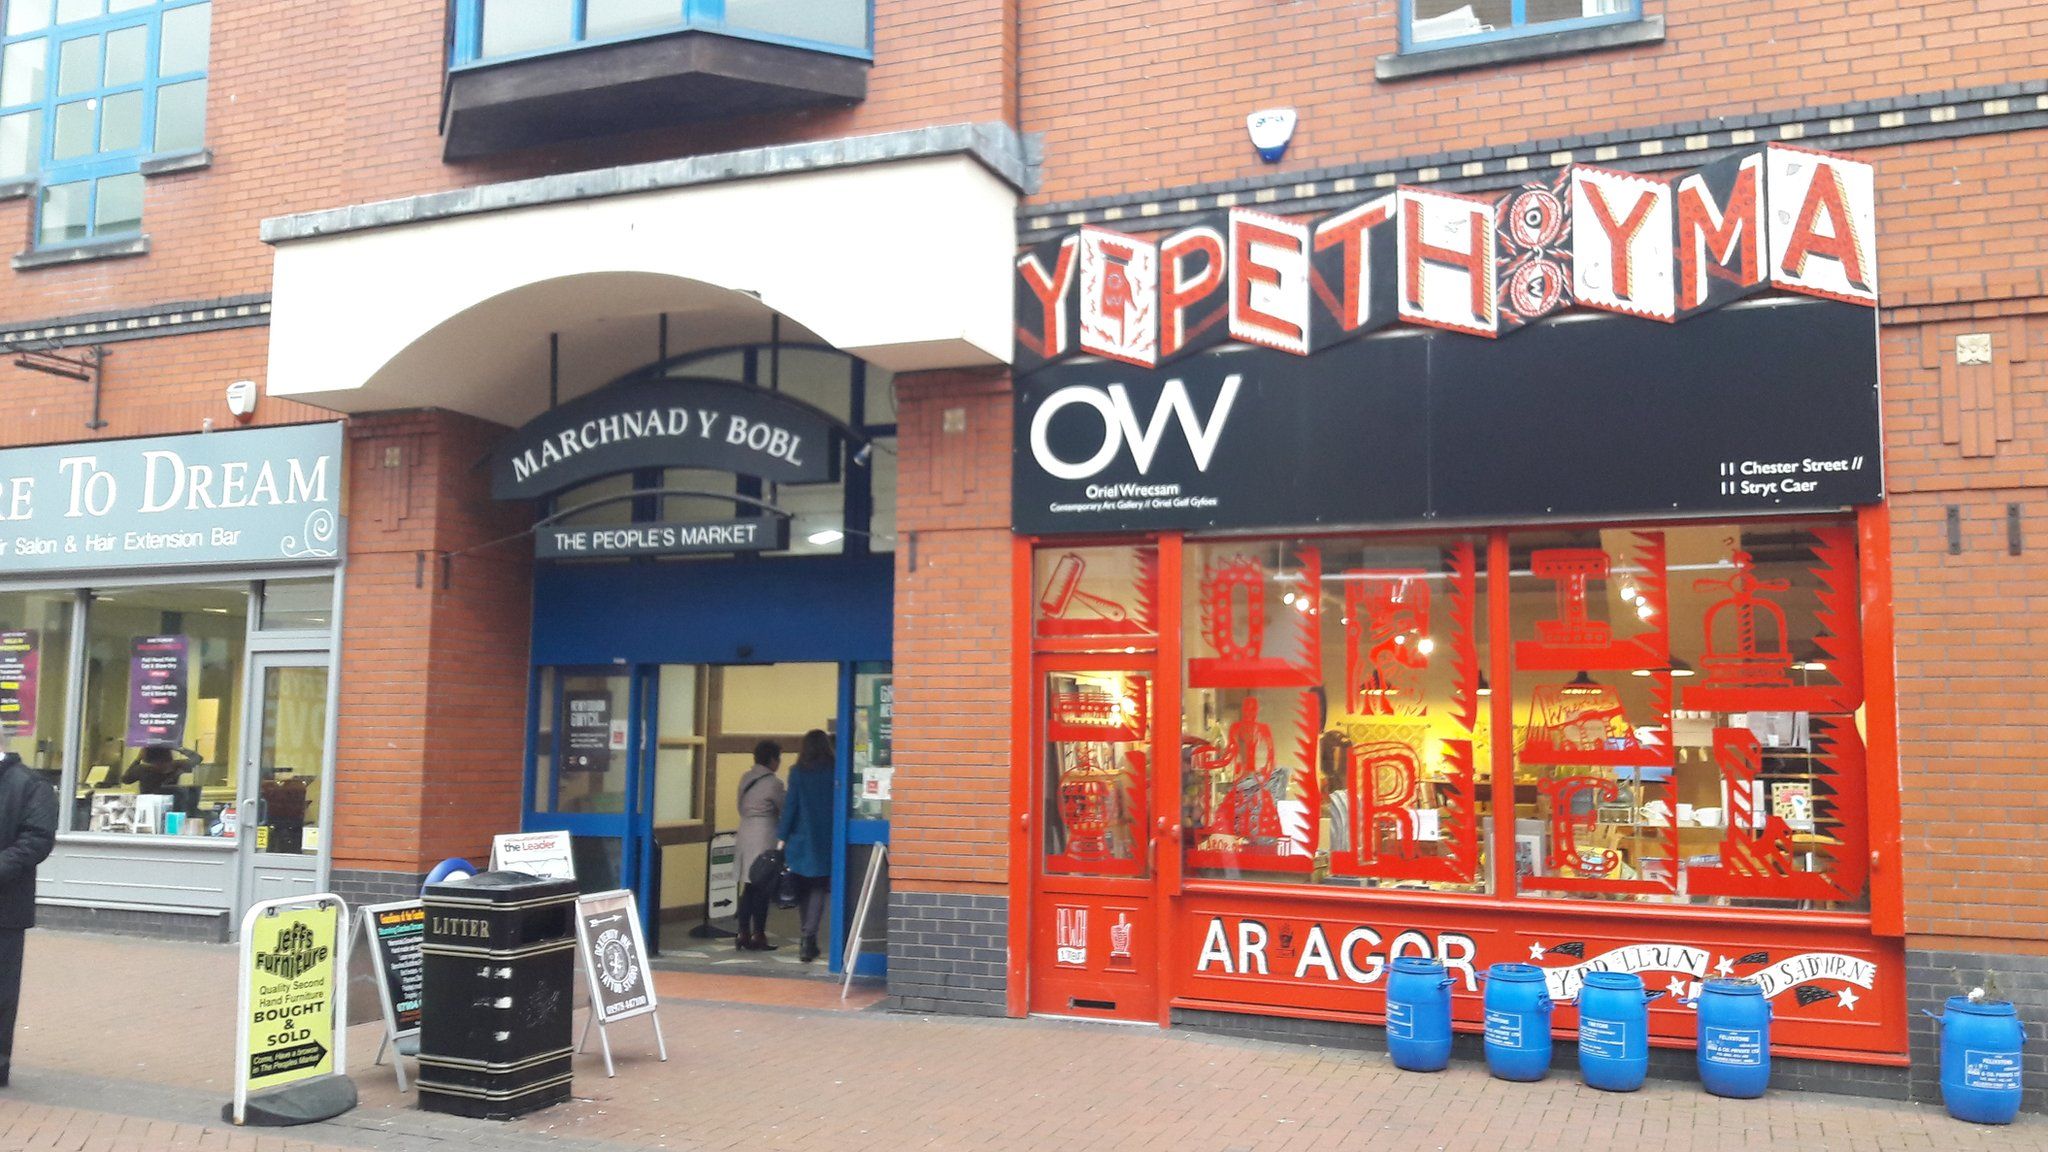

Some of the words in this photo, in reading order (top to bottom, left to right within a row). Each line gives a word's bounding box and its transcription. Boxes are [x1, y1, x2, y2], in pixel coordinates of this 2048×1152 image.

[1030, 373, 1243, 480] OW
[511, 407, 689, 483] MARCHNAD
[698, 410, 718, 439] Y
[726, 415, 804, 467] BOBL
[1740, 461, 1799, 475] Chester
[1802, 458, 1848, 472] Street
[1085, 484, 1118, 498] Oriel
[1119, 484, 1180, 497] Wrecsam
[1740, 480, 1777, 497] Stryt
[1780, 479, 1817, 492] Caer
[1049, 502, 1101, 513] Contemporary
[1102, 500, 1116, 510] Art
[1117, 500, 1143, 511] Gallery
[1151, 498, 1172, 508] Oriel
[15, 536, 57, 555] Salon
[64, 535, 77, 553] &
[85, 533, 117, 552] Hair
[124, 529, 203, 550] Extension
[211, 527, 241, 547] Bar
[554, 532, 587, 551] THE
[592, 528, 675, 550] PEOPLE'S
[681, 525, 758, 546] MARKET
[504, 842, 520, 853] the
[522, 840, 555, 851] Leader
[433, 917, 490, 938] LITTER
[1196, 916, 1269, 975] AR
[255, 945, 328, 981] Furniture
[260, 982, 290, 995] Quality
[293, 977, 324, 990] Second
[259, 996, 283, 1007] Hand
[284, 990, 324, 1004] Furniture
[253, 1001, 325, 1024] BOUGHT
[284, 1018, 295, 1030] &
[267, 1028, 311, 1046] SOLD
